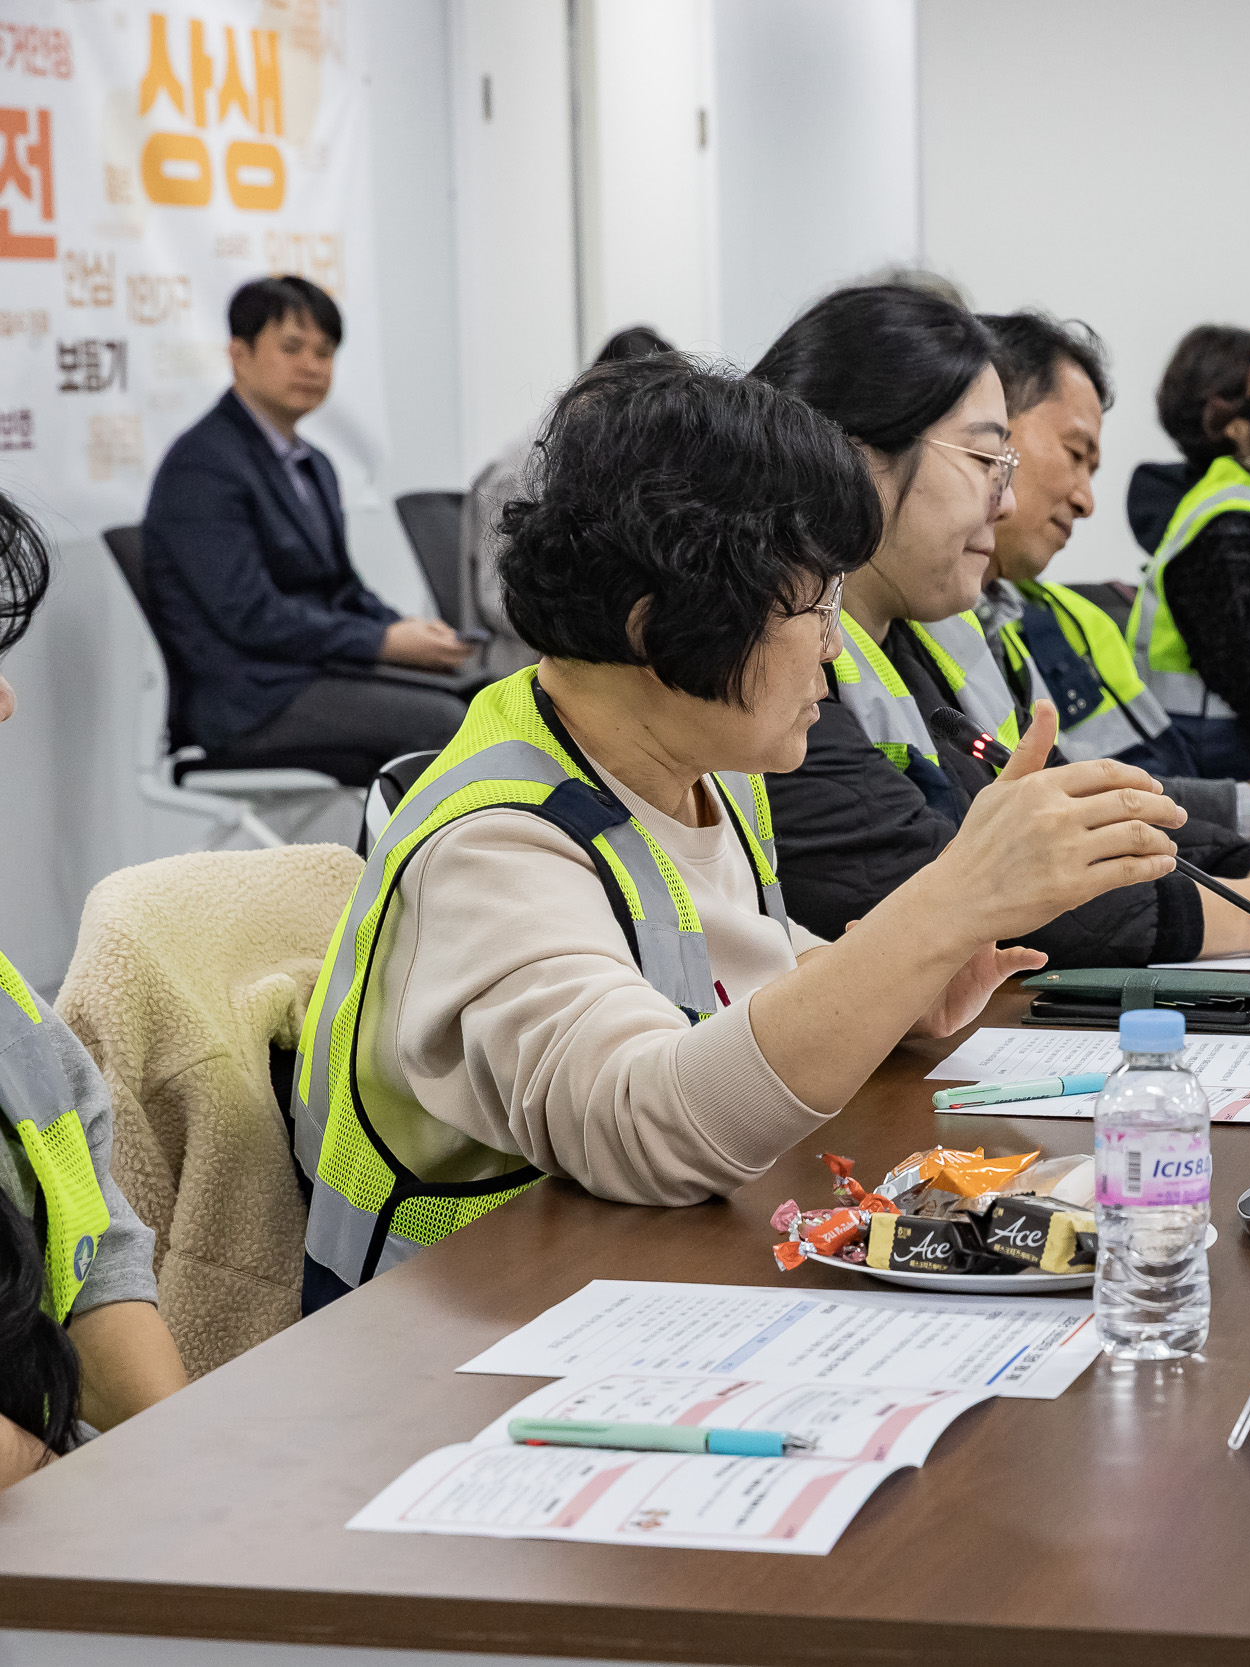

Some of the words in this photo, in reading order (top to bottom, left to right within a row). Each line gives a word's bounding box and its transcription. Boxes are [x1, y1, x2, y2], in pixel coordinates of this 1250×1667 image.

[0, 23, 73, 80] 거안정
[138, 13, 286, 211] 상생
[0, 107, 57, 260] 전
[57, 338, 127, 393] 보듬기
[1152, 1159, 1194, 1179] ICIS
[893, 1230, 953, 1263] Ace
[986, 1215, 1047, 1248] Ace
